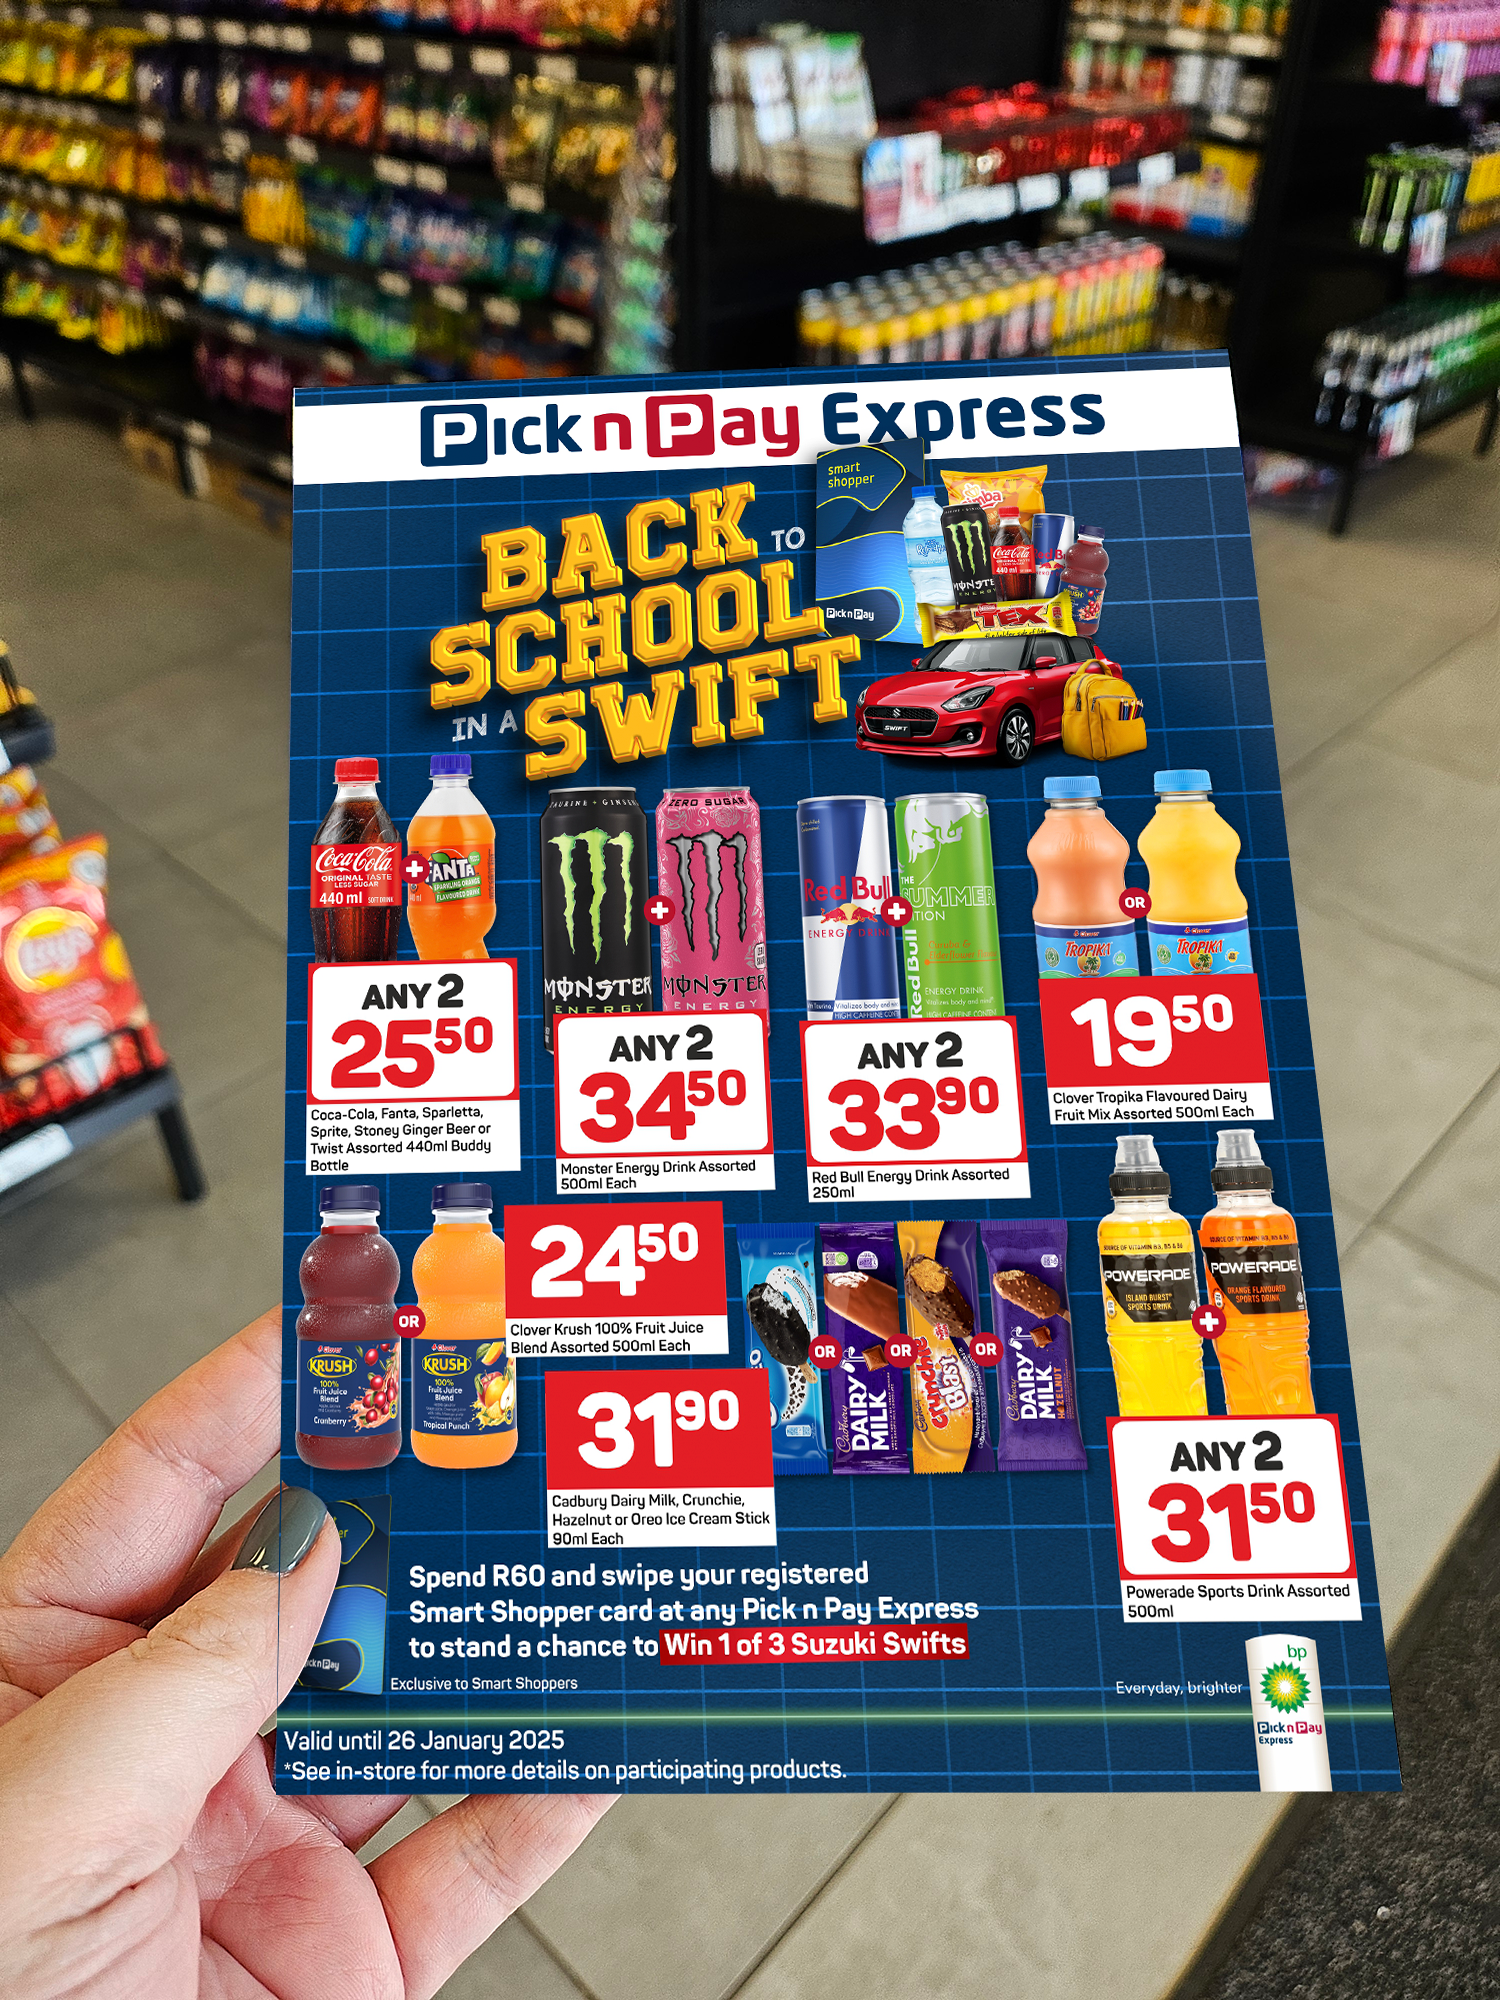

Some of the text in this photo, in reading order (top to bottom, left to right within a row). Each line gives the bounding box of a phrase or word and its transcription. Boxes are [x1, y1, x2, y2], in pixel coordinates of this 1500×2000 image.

[421, 392, 1105, 467] Pick n Pay Express
[828, 462, 860, 475] smart
[828, 473, 874, 490] shopper
[481, 481, 805, 612] BACK TO
[430, 559, 826, 709] SCHOOL
[452, 634, 860, 781] IN A SWIFT
[316, 846, 393, 873] Coca-Cola
[426, 859, 475, 882] FANTA
[804, 876, 890, 901] Red Bull
[1177, 939, 1222, 954] TROPIKA
[362, 973, 463, 1010] ANY 2
[545, 976, 651, 1001] MONSTER
[664, 975, 766, 998] MONSTER
[609, 1024, 713, 1062] ANY 2
[858, 1031, 963, 1069] ANY 2
[1053, 1089, 1247, 1104] Clover Tropika Flavoured Dairy
[311, 1106, 483, 1121] Coca-Cola, Fanta, Sparletta,
[1055, 1105, 1254, 1121] Fruit Mix Assorted 500ml Each
[311, 1123, 491, 1139] Sprite, Stoney Ginger Beer or
[311, 1140, 491, 1154] Twist Assorted 440ml Buddy
[311, 1159, 349, 1171] Bottle
[561, 1160, 756, 1176] Monster Energy Drink Assorted
[561, 1177, 636, 1190] 500ml Each
[812, 1168, 1010, 1184] Red Bull Energy Drink Assorted
[813, 1186, 854, 1198] 250ml
[1105, 1268, 1191, 1281] POWERADE
[1211, 1260, 1297, 1274] POWERADE
[511, 1321, 704, 1336] Clover Krush 100% Fruit Juice
[511, 1340, 690, 1353] Blend Assorted 500ml Each
[310, 1359, 352, 1376] KRUSH
[425, 1358, 467, 1375] KRUSH
[848, 1375, 870, 1451] DAIRY
[869, 1390, 889, 1450] MILK
[1170, 1430, 1283, 1472] ANY 2
[552, 1493, 744, 1510] Cadbury Dairy Milk, Crunchie,
[552, 1512, 770, 1526] Hazelnut or Oreo Ice Cream Stick
[553, 1532, 623, 1545] 90ml Each
[409, 1561, 869, 1592] Spend R60 and swipe your registered
[1127, 1584, 1350, 1601] Powerade Sports Drink Assorted
[409, 1597, 979, 1627] Smart Shopper card at any Pick n Pay Express
[1128, 1605, 1173, 1618] 500ml
[409, 1631, 966, 1658] to stand a chance to Win 1 of 3 Suzuki Swifts
[1287, 1644, 1307, 1661] bp
[391, 1676, 577, 1692] Exclusive to Smart Shoppers
[1116, 1682, 1243, 1696] Everyday, brighter
[1257, 1721, 1322, 1735] Pick n Pay
[284, 1730, 564, 1754] Valid until 26 January 2025
[1259, 1736, 1293, 1746] Express
[337, 1762, 414, 1780] in-store
[421, 1761, 449, 1779] for
[455, 1764, 505, 1779] more
[516, 1760, 579, 1779] details
[587, 1763, 609, 1778] on
[616, 1760, 744, 1784] participating
[750, 1760, 847, 1784] products.
